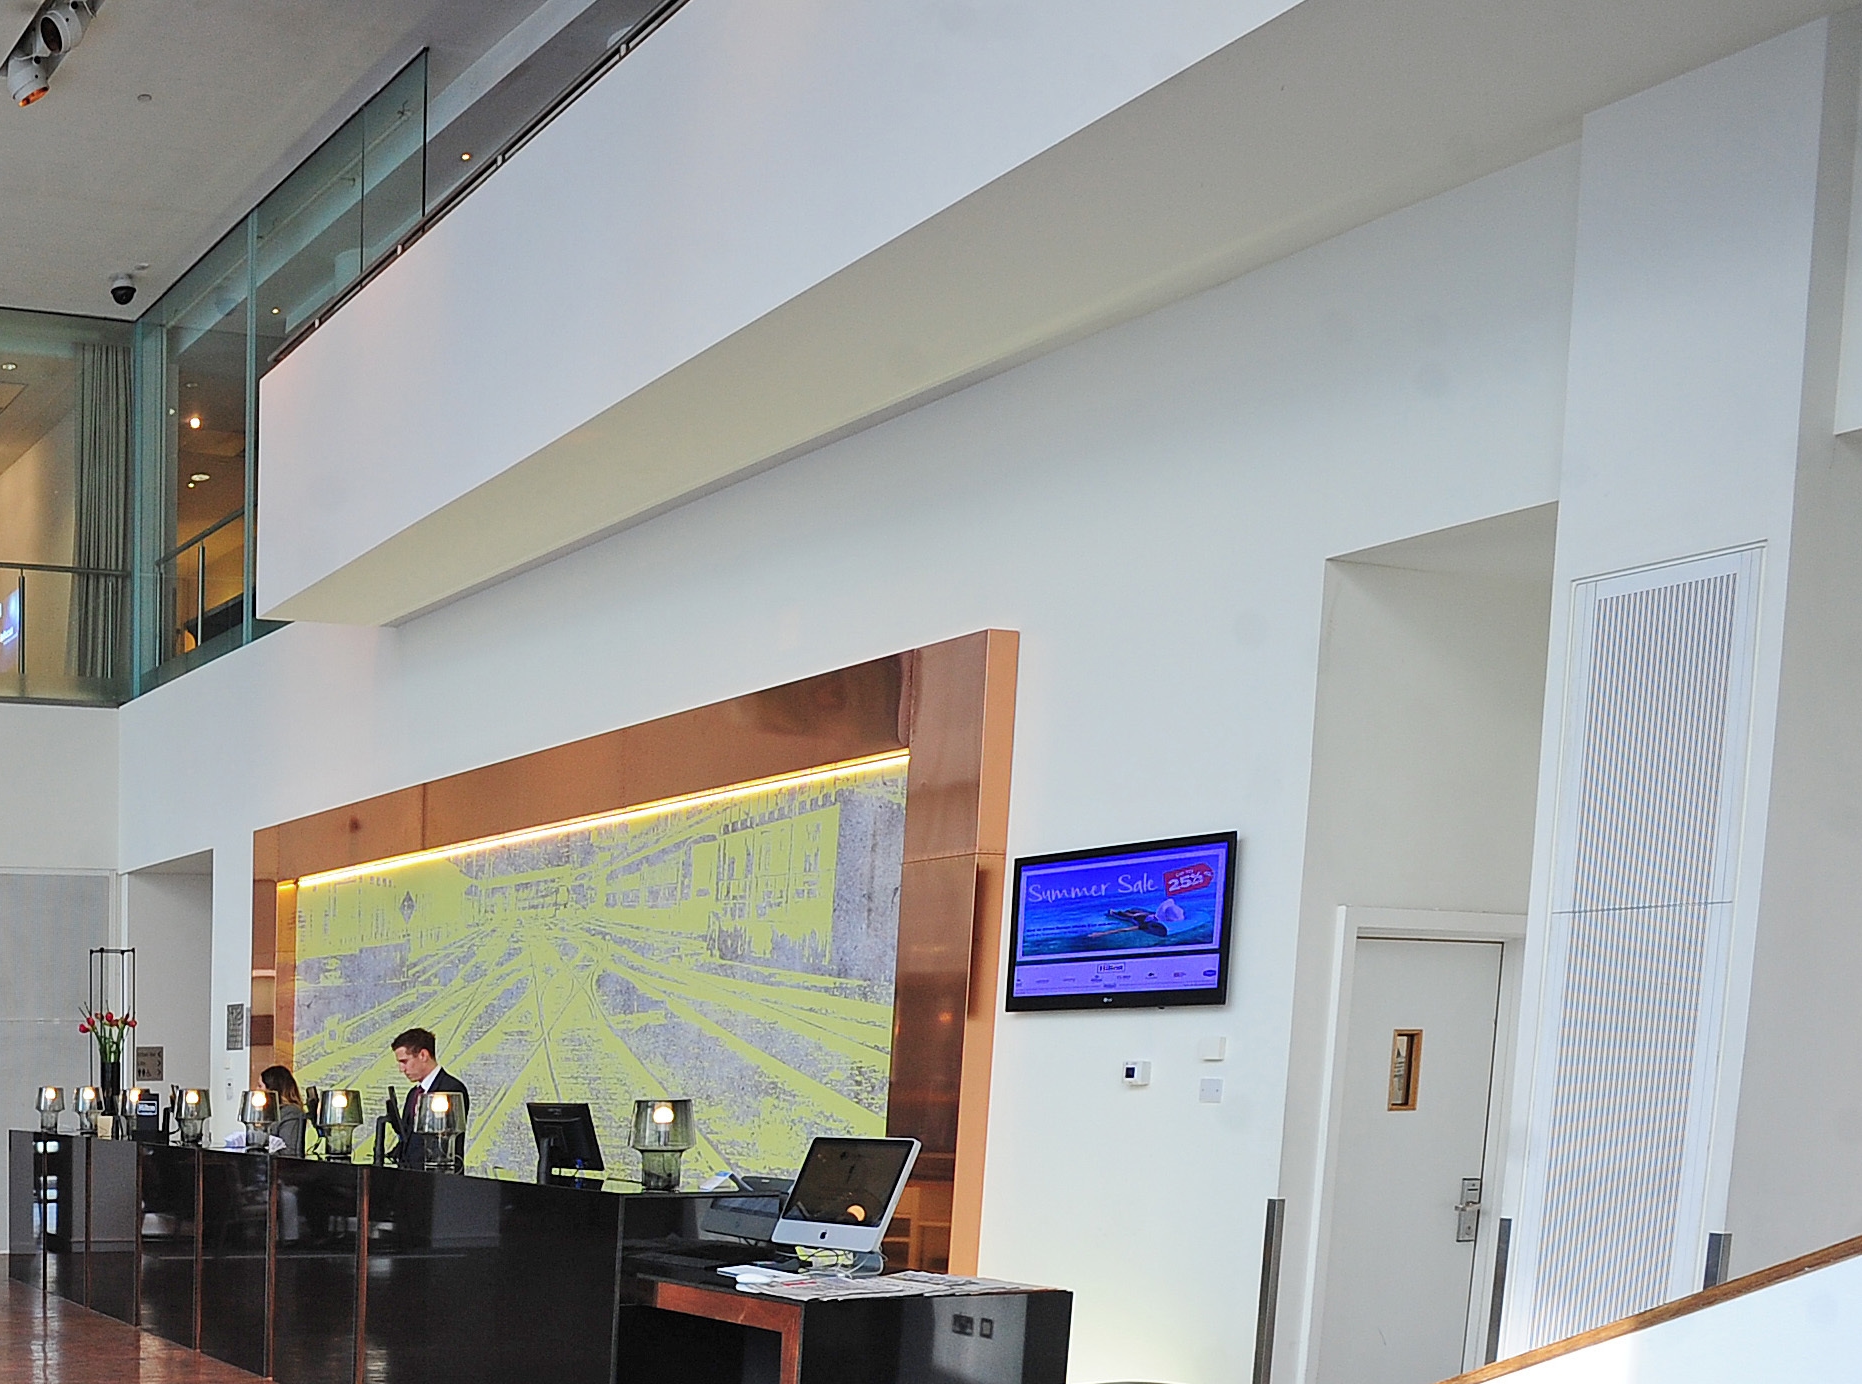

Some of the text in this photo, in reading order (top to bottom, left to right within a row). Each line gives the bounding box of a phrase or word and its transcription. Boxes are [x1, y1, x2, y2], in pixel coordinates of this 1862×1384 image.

[1028, 872, 1158, 903] Summer Sale
[1168, 871, 1204, 892] 25%
